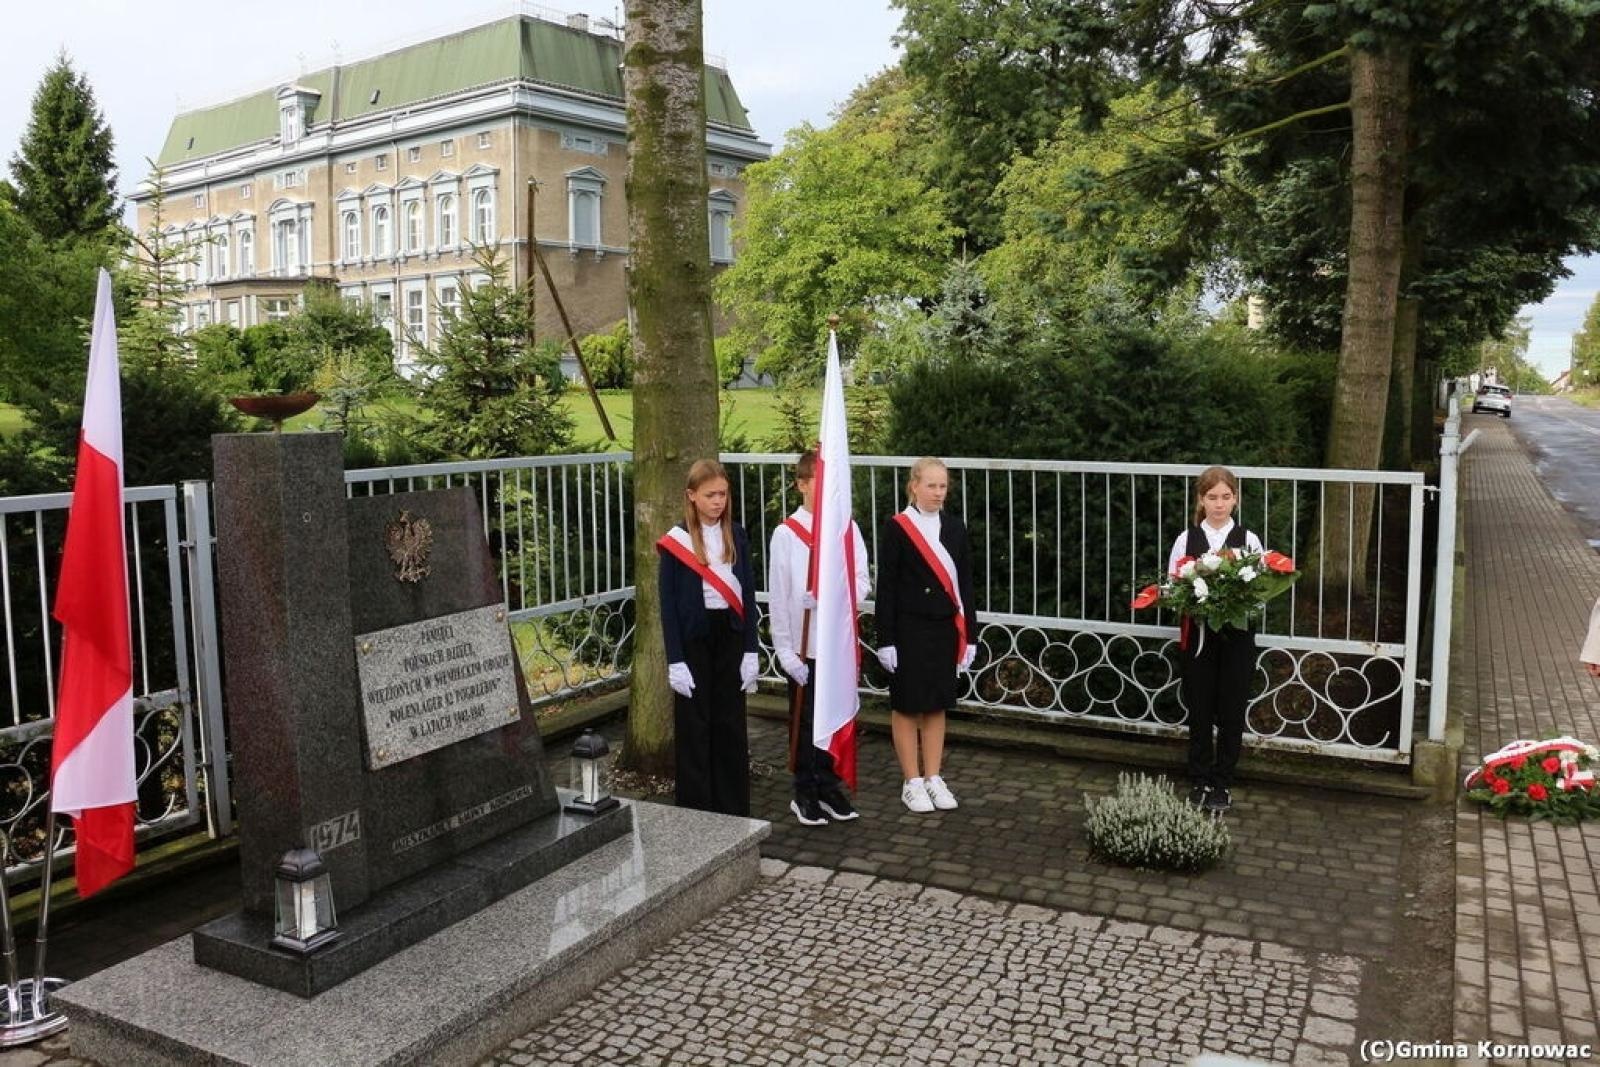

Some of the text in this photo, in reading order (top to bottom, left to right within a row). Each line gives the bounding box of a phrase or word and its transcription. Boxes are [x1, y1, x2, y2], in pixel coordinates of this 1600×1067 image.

[404, 649, 444, 673] POLSKICH
[425, 676, 432, 690] W
[409, 726, 418, 739] W
[312, 810, 359, 853] 1974
